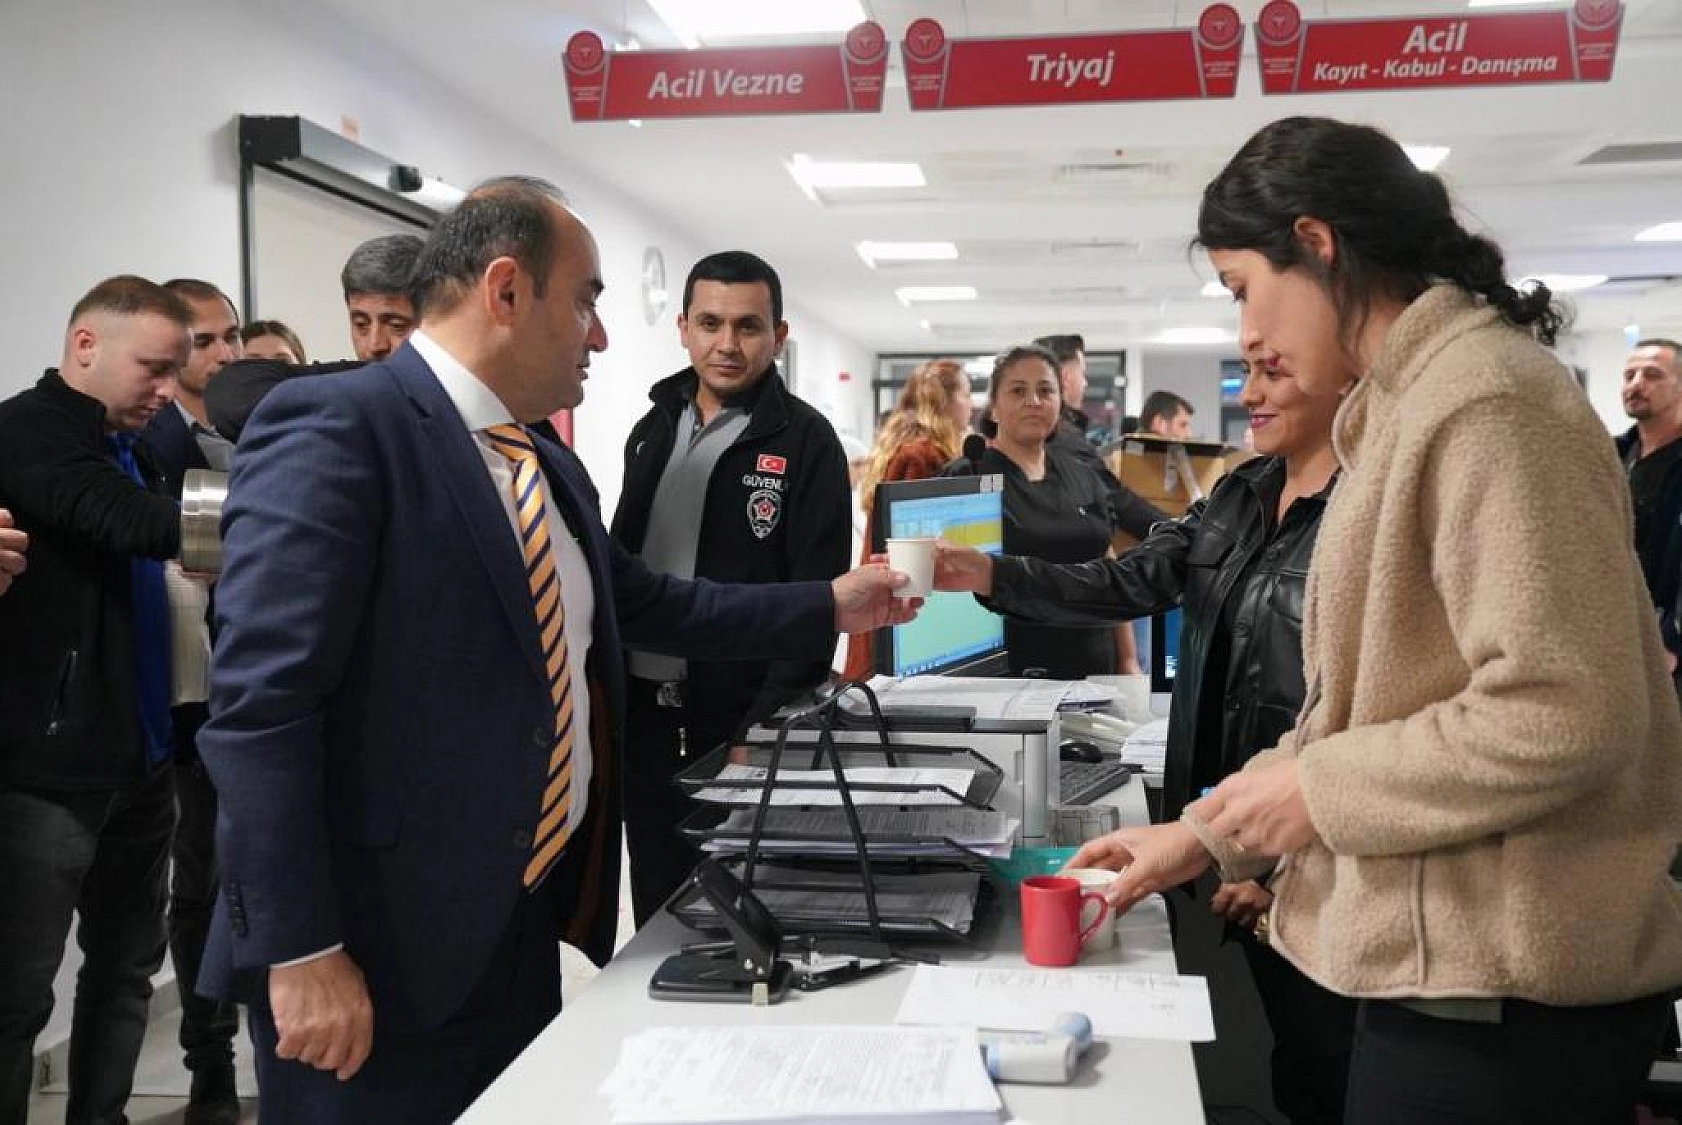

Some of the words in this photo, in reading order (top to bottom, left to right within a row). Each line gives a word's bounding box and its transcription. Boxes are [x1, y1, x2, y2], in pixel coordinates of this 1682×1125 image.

[1402, 22, 1467, 54] Acil
[648, 68, 706, 99] Acil
[712, 69, 804, 97] Vezne
[1027, 50, 1115, 87] Triyaj
[1313, 61, 1368, 84] Kayıt
[1383, 57, 1445, 78] Kabul
[1460, 54, 1558, 77] Danışma
